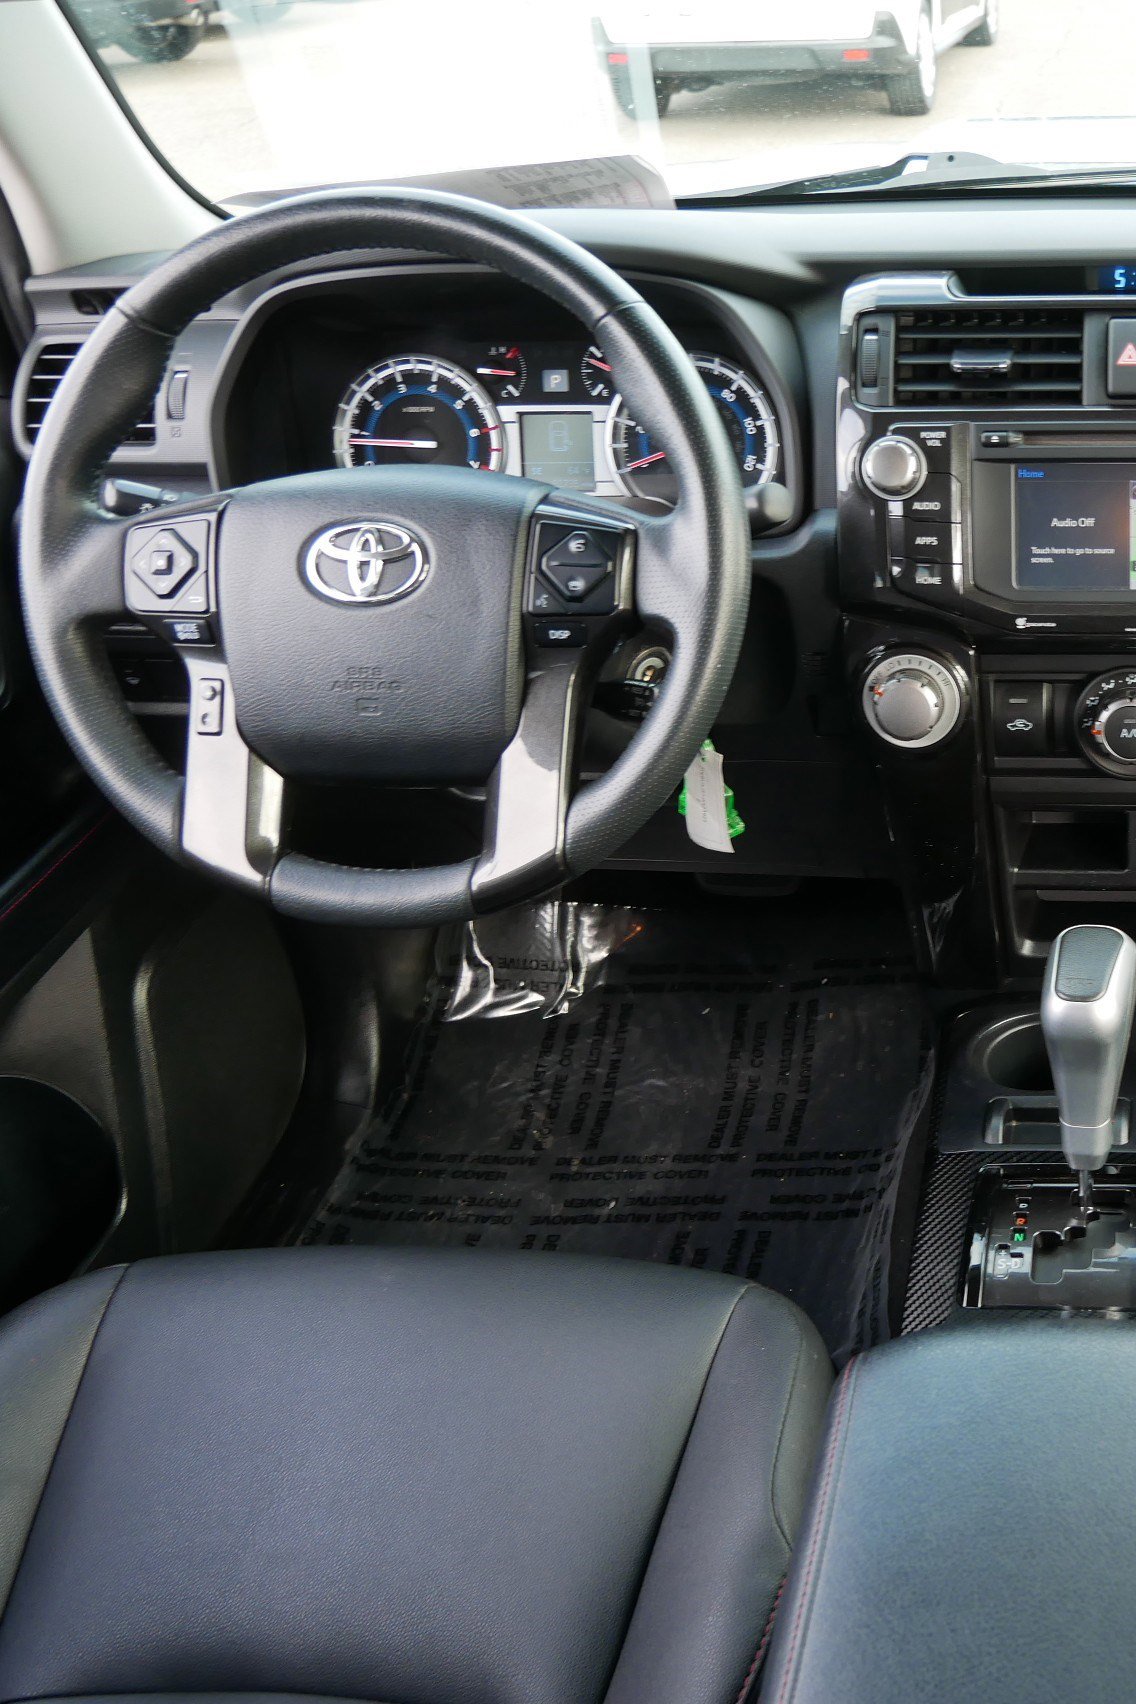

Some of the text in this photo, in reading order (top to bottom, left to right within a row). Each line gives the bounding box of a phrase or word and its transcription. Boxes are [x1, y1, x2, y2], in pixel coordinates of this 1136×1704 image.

[396, 384, 408, 394] 3
[427, 384, 439, 393] 4
[720, 388, 737, 403] 80
[742, 417, 757, 435] 100
[469, 428, 481, 438] 6
[920, 431, 947, 439] POWER
[926, 439, 943, 447] VOL
[1017, 469, 1045, 478] Home
[912, 502, 942, 510] AUDIO
[1051, 518, 1096, 527] Audio Off
[914, 536, 939, 546] APPS
[1031, 547, 1050, 555] Touch
[1051, 547, 1066, 555] here
[915, 576, 942, 585] HOME
[548, 630, 571, 640] DISP
[556, 1156, 619, 1167] DEALER
[672, 1152, 740, 1164] REMOVE
[549, 1169, 710, 1182] PROTECTIVE COVER
[1013, 1233, 1025, 1241] N
